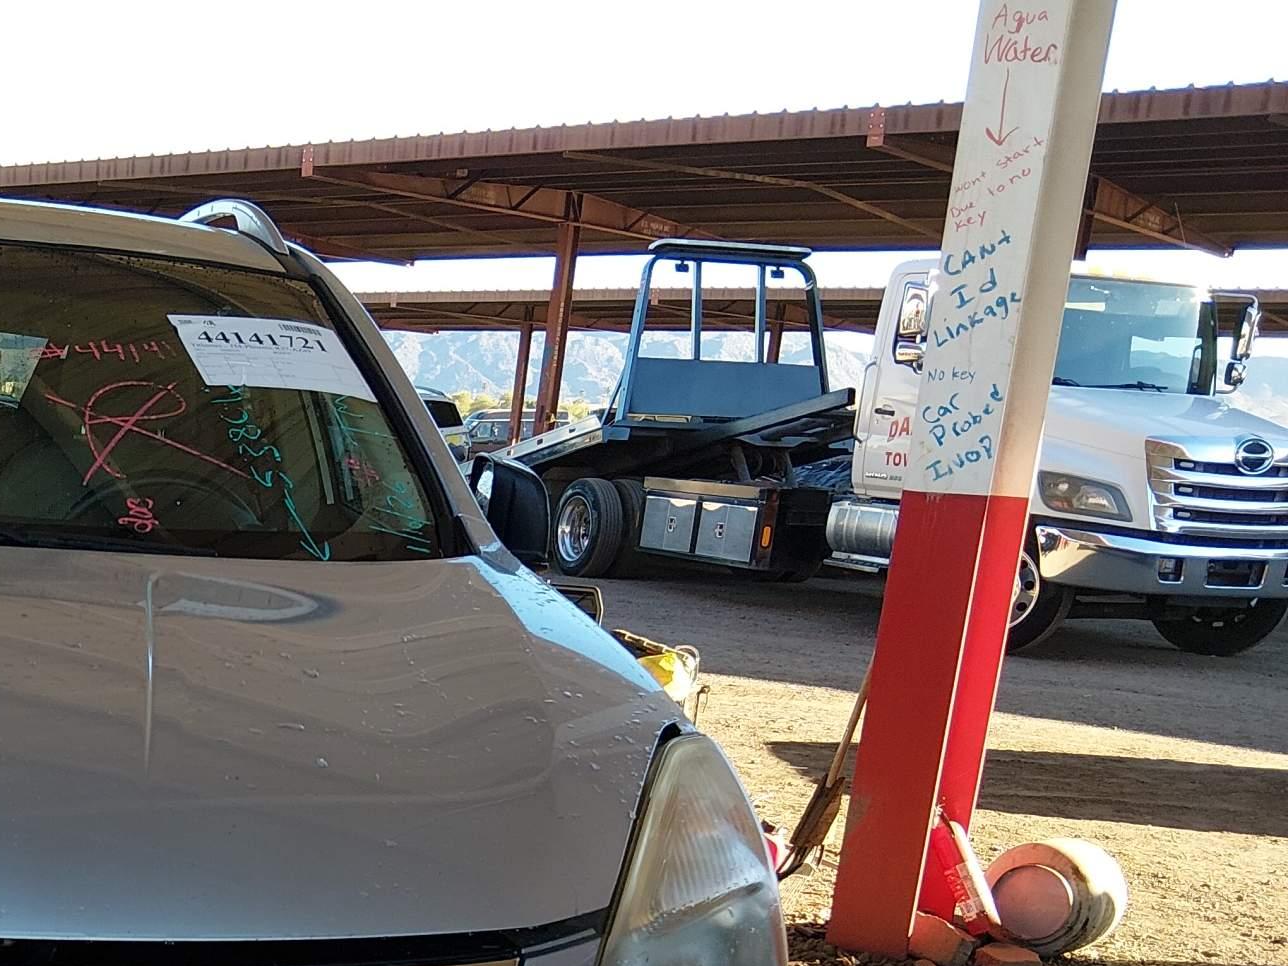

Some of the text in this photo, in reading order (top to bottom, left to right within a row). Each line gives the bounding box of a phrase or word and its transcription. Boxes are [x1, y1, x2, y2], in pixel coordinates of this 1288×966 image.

[991, 3, 1049, 34] Agua
[197, 330, 328, 352] 44141721
[922, 392, 960, 424] Car
